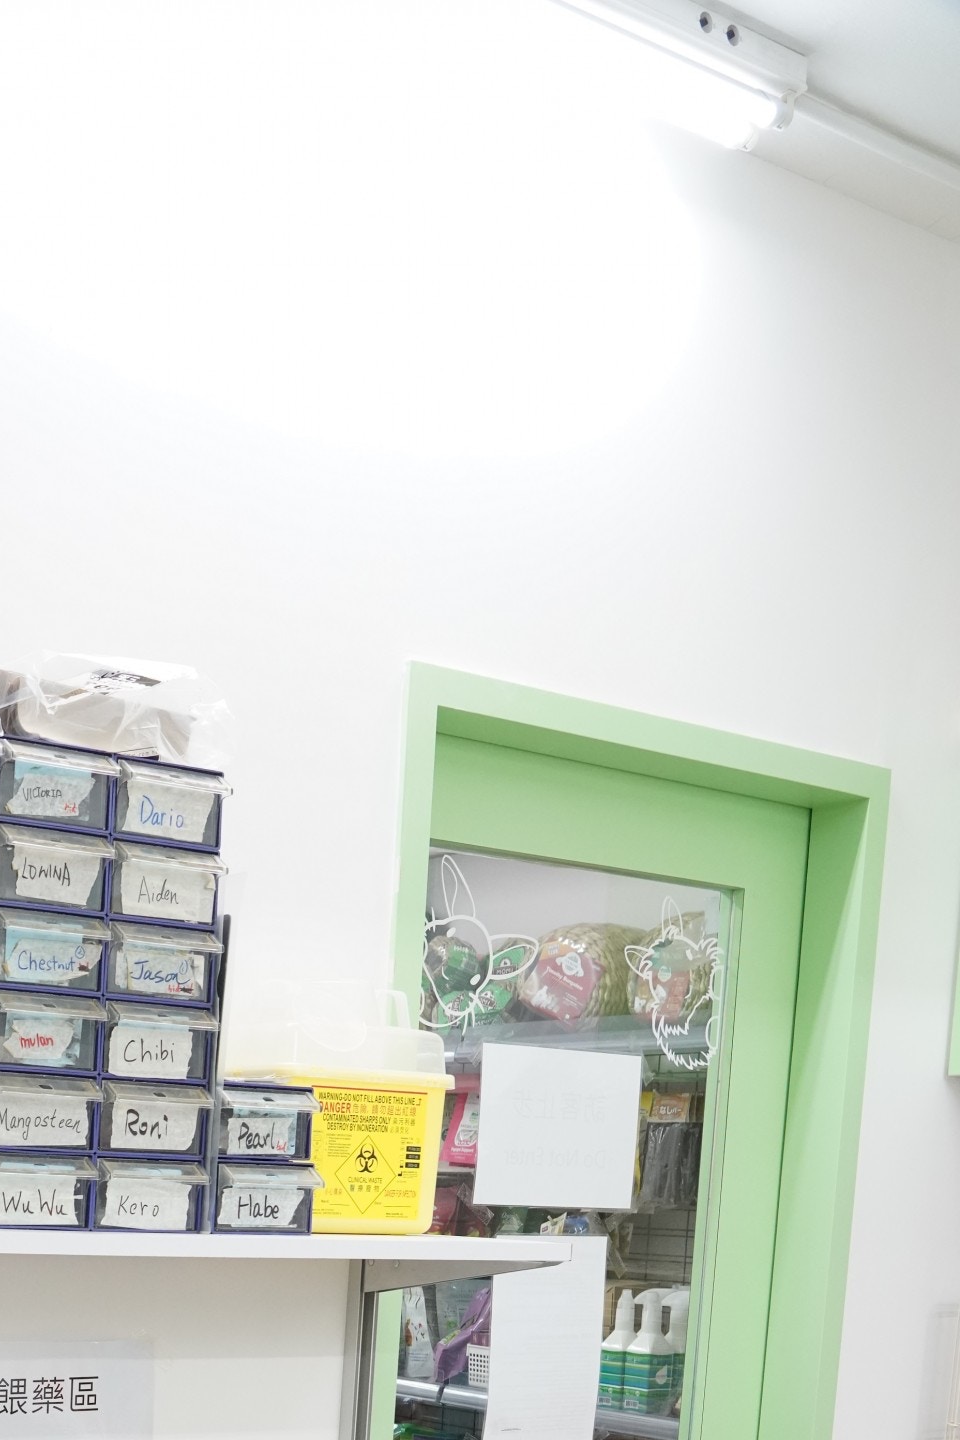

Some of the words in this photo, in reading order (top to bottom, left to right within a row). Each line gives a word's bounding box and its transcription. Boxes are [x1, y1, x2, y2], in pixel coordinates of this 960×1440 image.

[23, 787, 62, 801] VICTORIA
[140, 794, 184, 829] Dario
[138, 875, 179, 905] Aiden
[17, 950, 75, 972] Chestnut
[130, 960, 190, 985] Jason
[123, 1038, 175, 1063] Chibi
[352, 1093, 363, 1103] NOT
[364, 1094, 373, 1103] FILL
[375, 1095, 392, 1105] ABOVE
[393, 1096, 404, 1105] THIS
[405, 1097, 416, 1106] LINE
[125, 1108, 168, 1140] Roni
[323, 1114, 359, 1123] CONTAMINATED
[360, 1115, 378, 1124] SHARPS
[379, 1116, 391, 1125] ONLY
[327, 1122, 349, 1131] DESTROY
[357, 1124, 388, 1133] INCINERATION
[238, 1122, 275, 1149] Pearl
[118, 1195, 160, 1217] Kero
[238, 1193, 280, 1220] Habe
